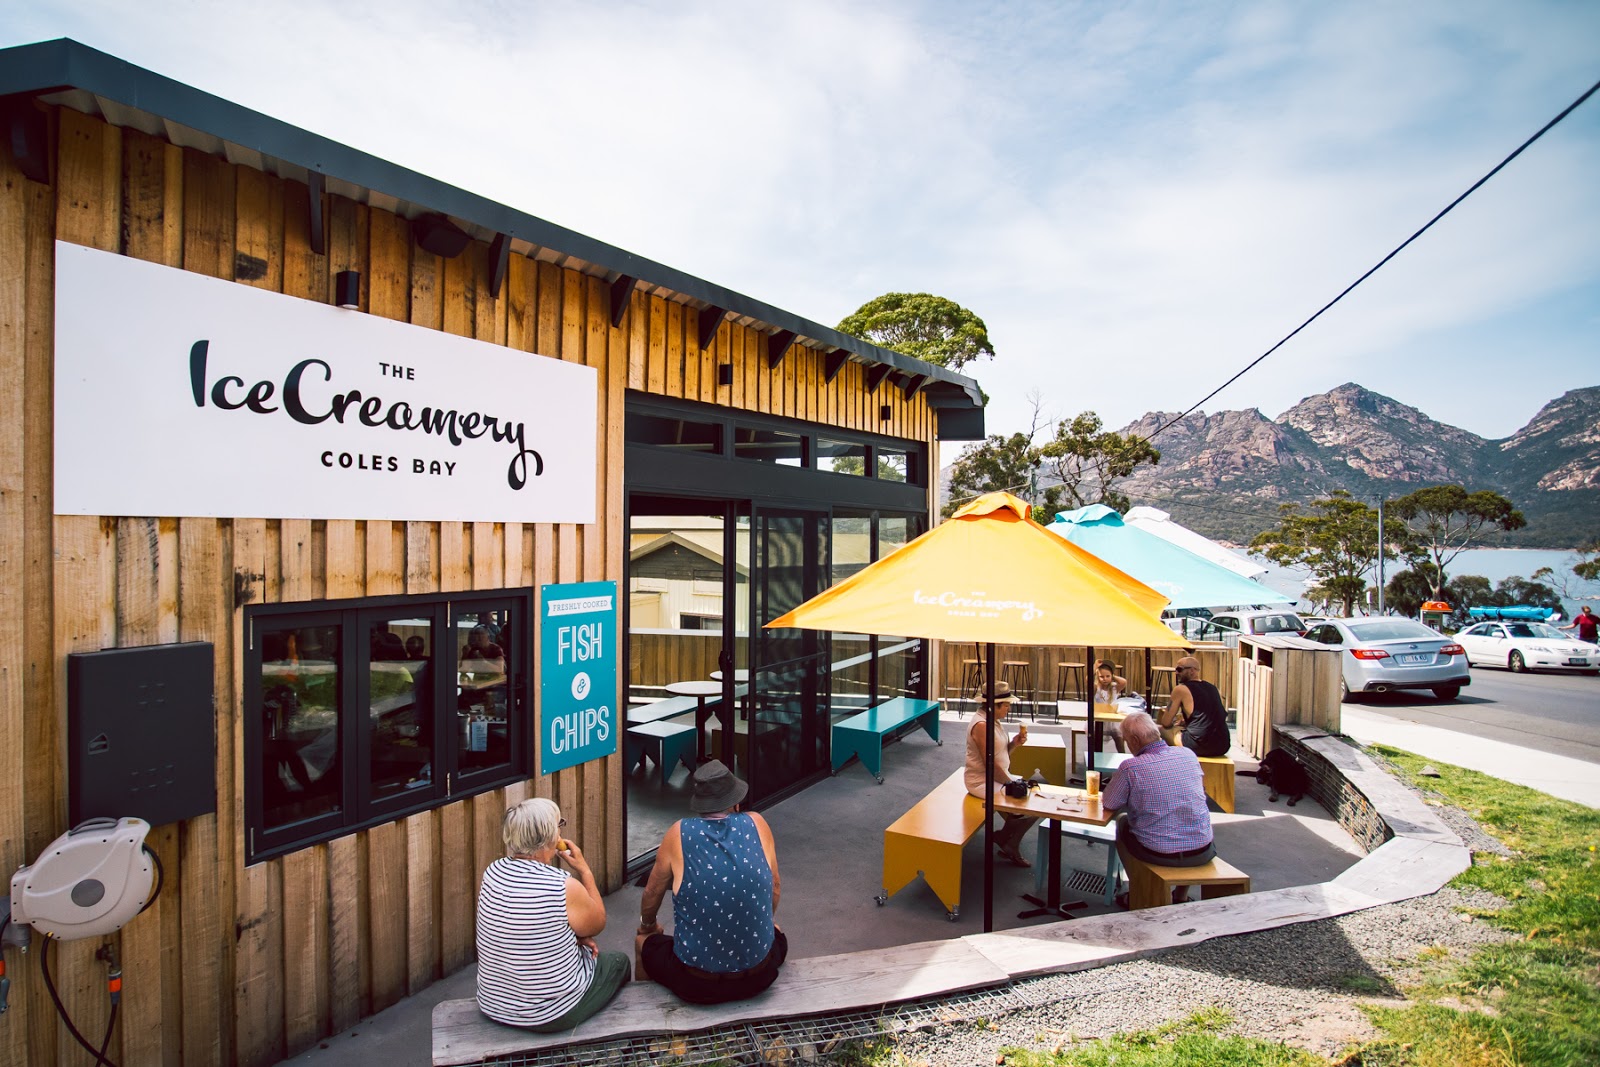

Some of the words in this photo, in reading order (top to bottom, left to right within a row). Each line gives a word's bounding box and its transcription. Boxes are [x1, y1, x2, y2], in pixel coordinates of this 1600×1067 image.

[379, 363, 414, 380] THE
[189, 340, 544, 490] IceCreamery
[321, 451, 397, 471] COLES
[413, 459, 456, 475] BAY
[552, 601, 582, 612] FRESHLY
[582, 600, 608, 609] COOKED
[914, 590, 1043, 621] IceCreamery
[558, 622, 602, 665] FISH
[577, 678, 586, 694] &
[550, 706, 609, 754] CHIPS
